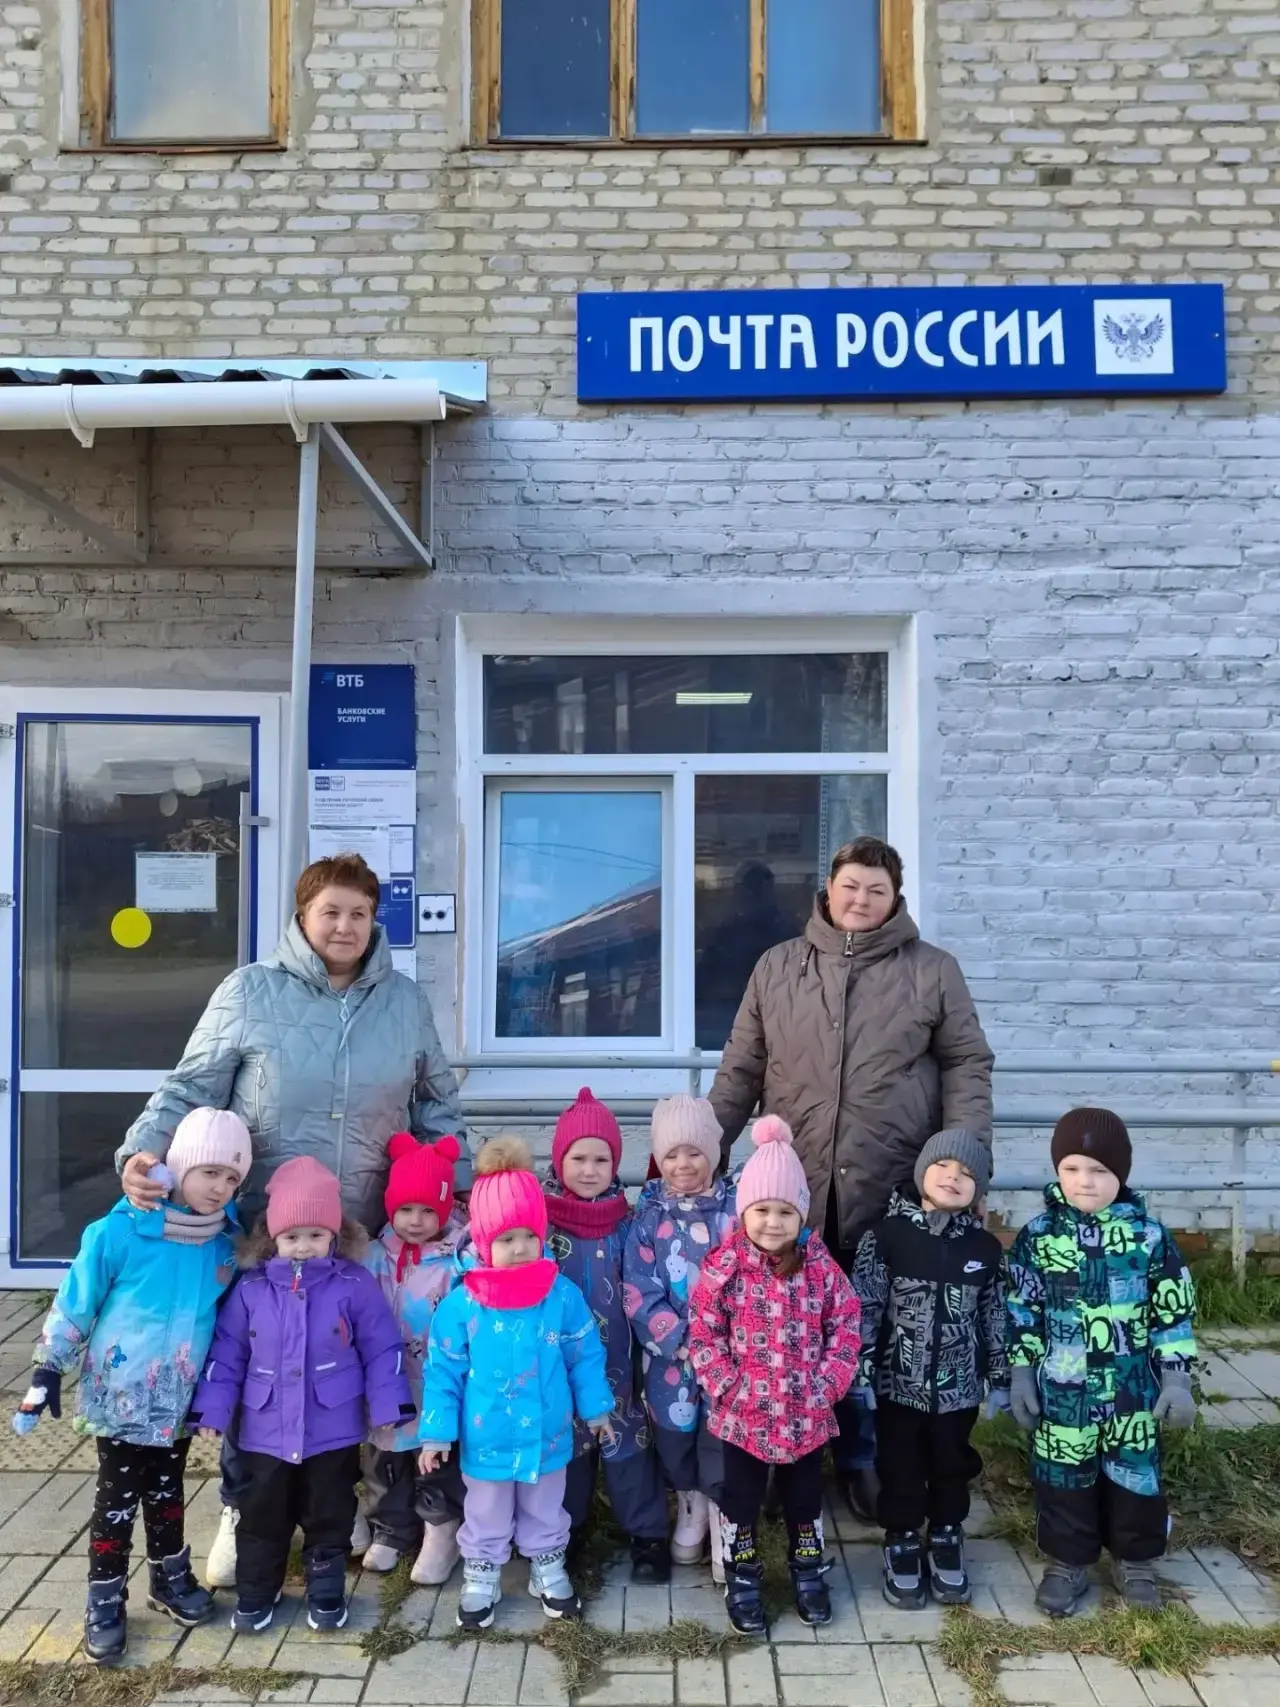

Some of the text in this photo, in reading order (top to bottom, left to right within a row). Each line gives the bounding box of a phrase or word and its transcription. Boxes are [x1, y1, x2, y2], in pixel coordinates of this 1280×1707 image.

[629, 308, 1065, 372] ПОЧТА РОССИИ
[336, 674, 365, 687] ВТБ
[991, 1311, 1006, 1320] JUS
